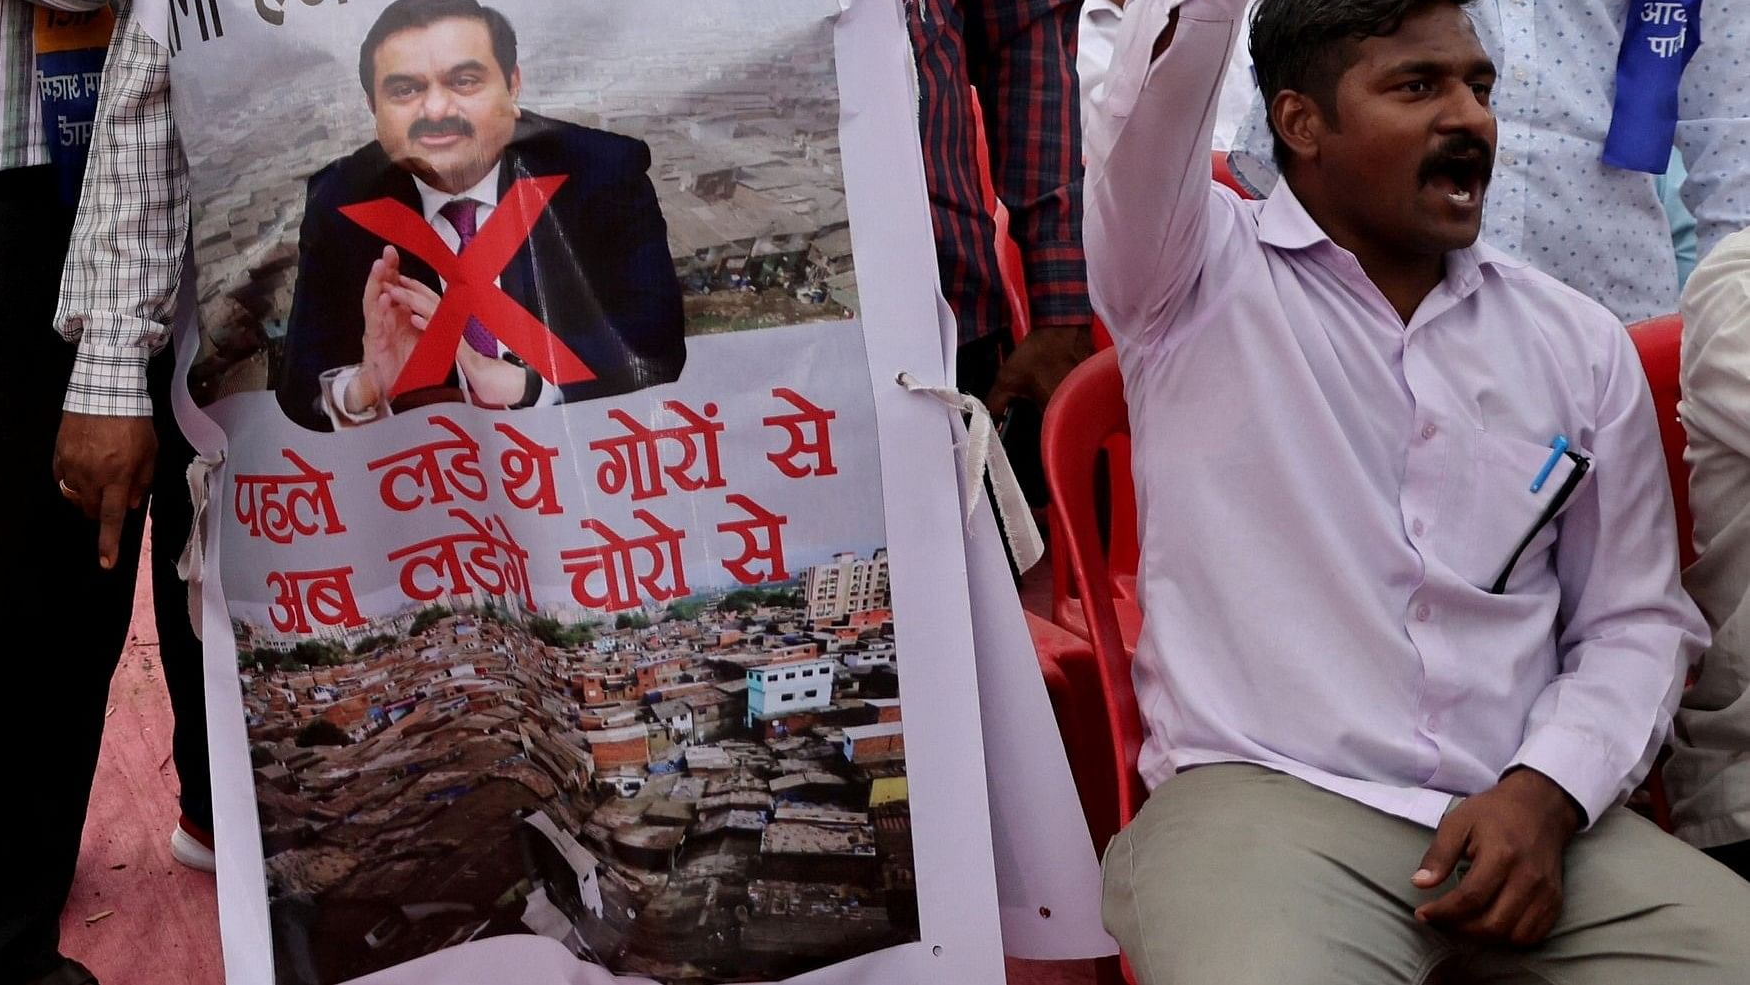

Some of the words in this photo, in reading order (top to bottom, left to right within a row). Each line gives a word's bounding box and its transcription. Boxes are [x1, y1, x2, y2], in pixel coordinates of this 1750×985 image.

[234, 448, 348, 545] पहले
[493, 421, 565, 516] थे
[589, 400, 727, 502] गोरों
[762, 387, 840, 479] से
[266, 565, 369, 636] अब
[716, 493, 791, 585] से
